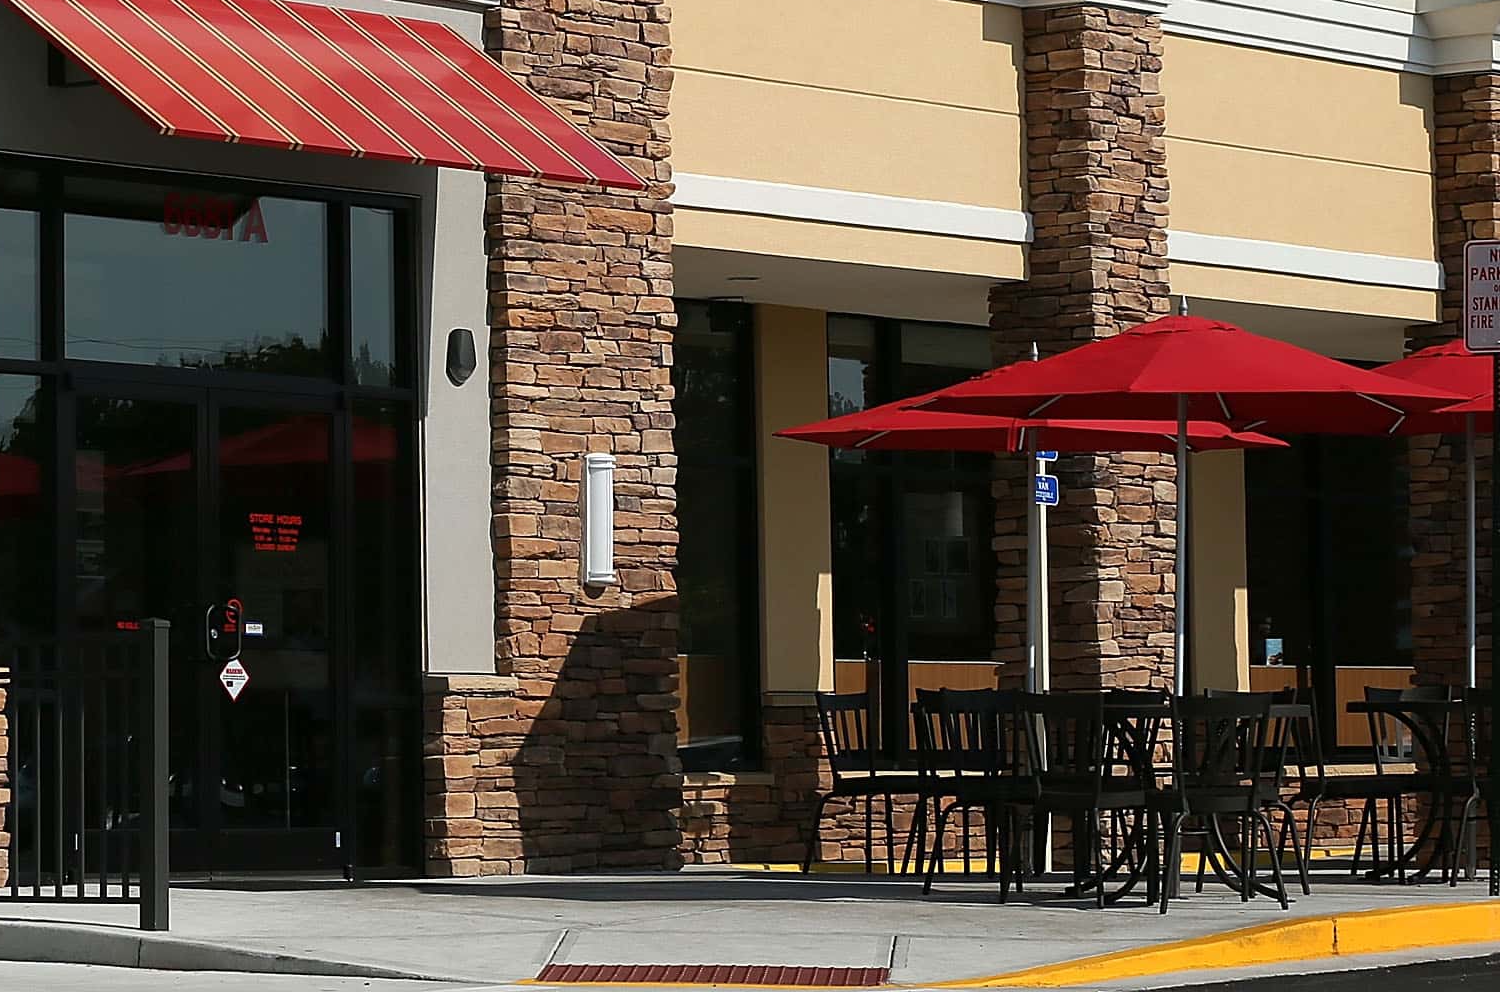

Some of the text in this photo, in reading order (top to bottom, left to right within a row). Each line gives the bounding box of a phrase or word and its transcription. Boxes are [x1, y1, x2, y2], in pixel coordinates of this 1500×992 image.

[1490, 249, 1500, 263] N
[1493, 284, 1500, 293] O
[1472, 297, 1500, 311] STAN
[1470, 315, 1494, 329] FIRE
